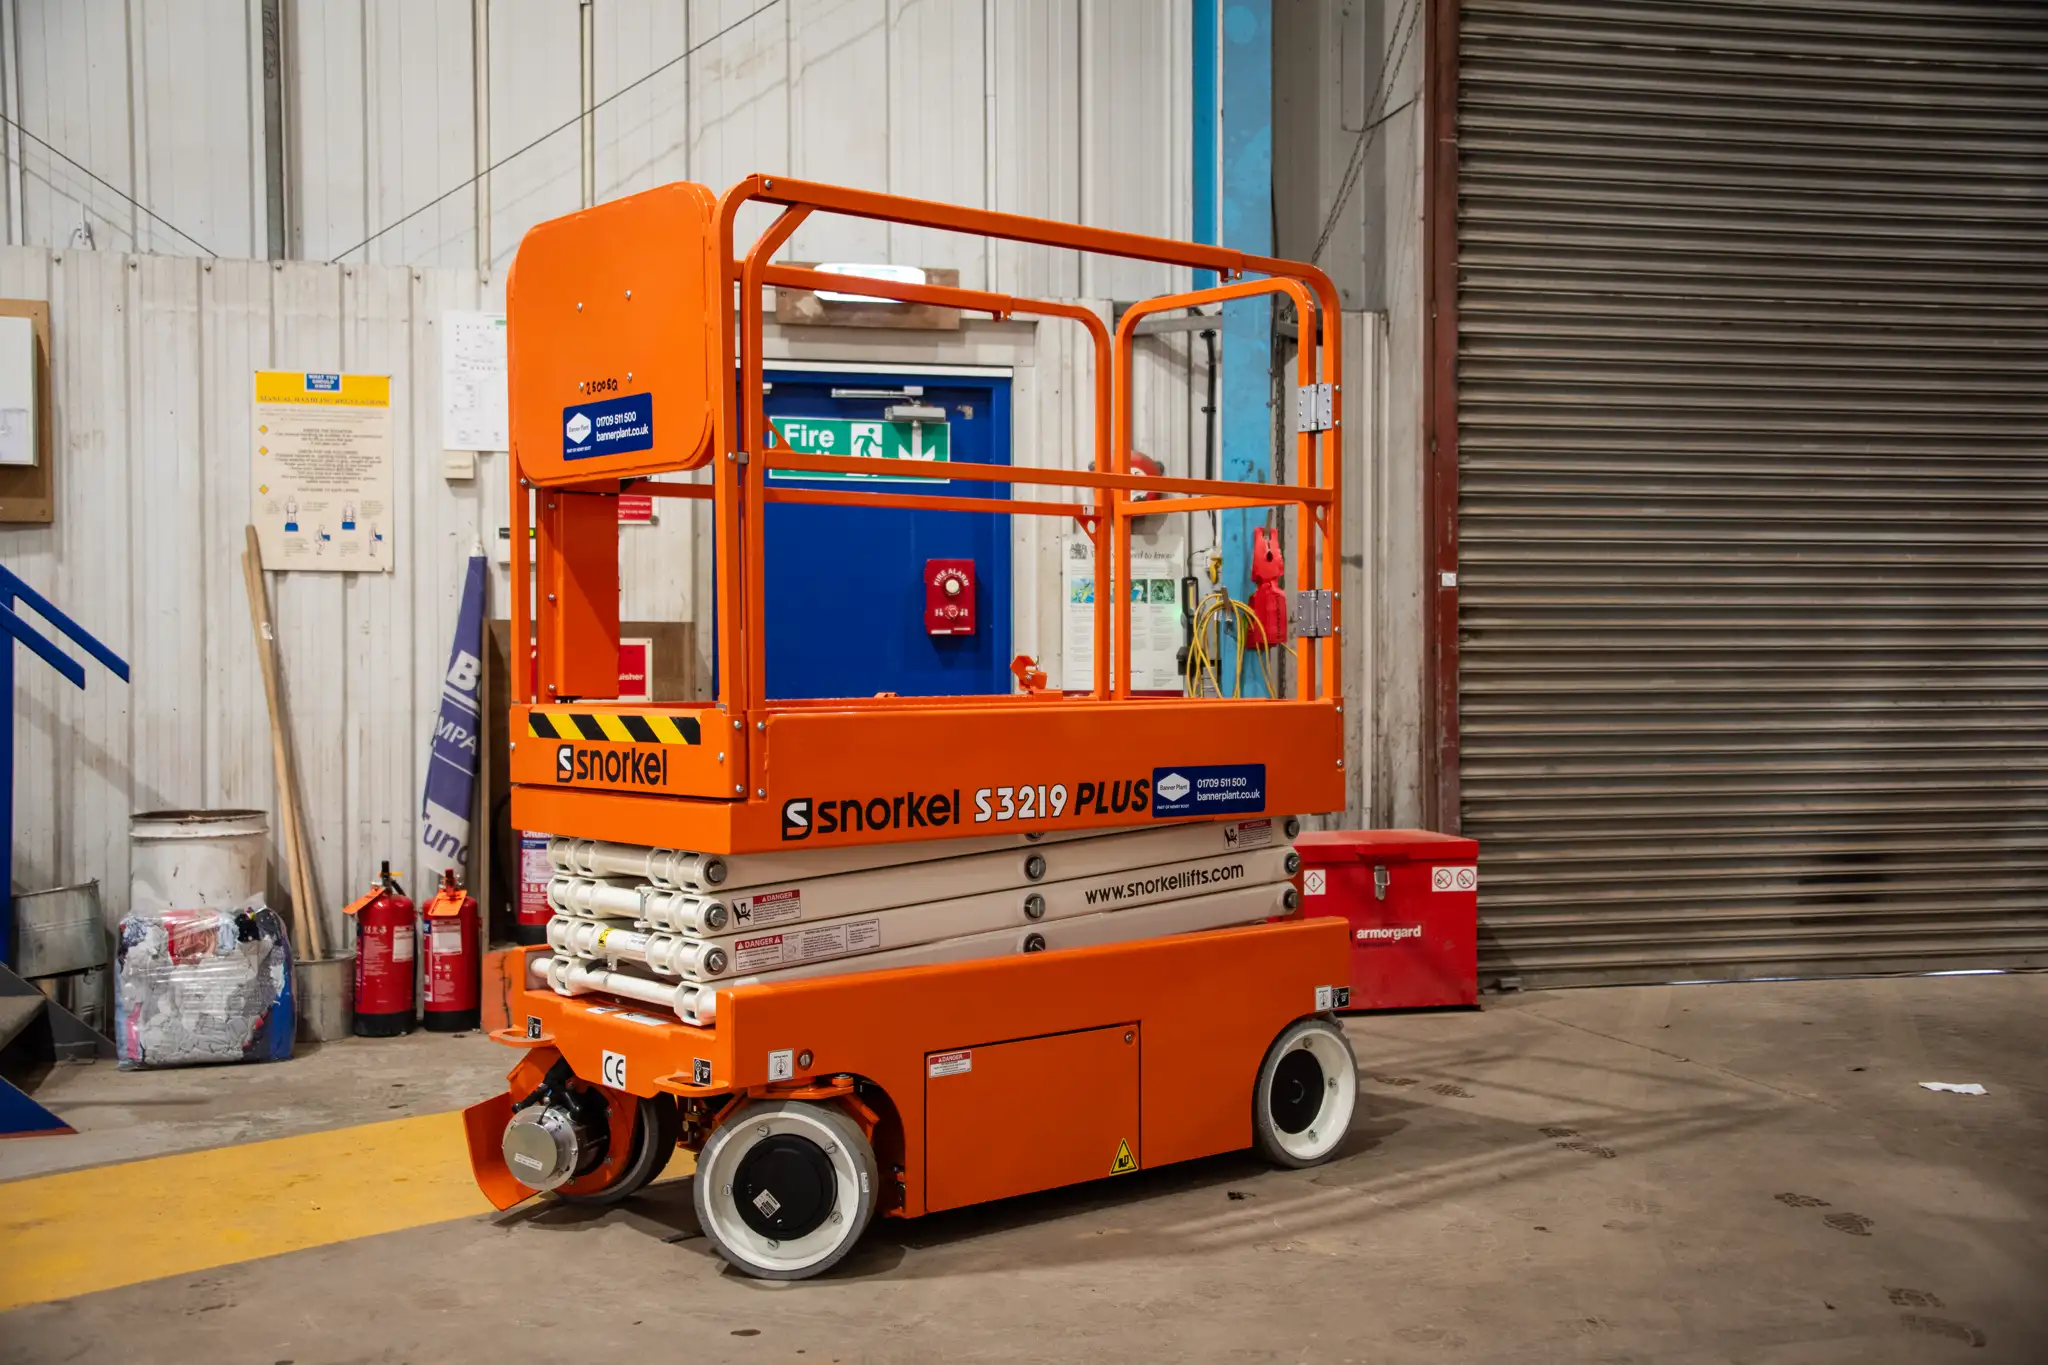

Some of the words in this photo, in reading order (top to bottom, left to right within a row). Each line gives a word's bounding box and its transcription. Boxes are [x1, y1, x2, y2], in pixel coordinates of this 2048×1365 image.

[596, 415, 613, 427] 01709
[614, 413, 623, 425] 511
[624, 411, 636, 423] 500
[596, 423, 649, 441] bannerplant.co.uk
[783, 424, 835, 447] Fire
[934, 569, 948, 586] FIRE
[948, 568, 970, 586] ALARM
[576, 747, 667, 786] snorkel
[1197, 778, 1219, 788] 01709
[1220, 777, 1231, 787] 511
[1232, 777, 1247, 787] 500
[1197, 789, 1260, 802] bannerplant.co.uk
[817, 789, 960, 834] snorkel
[974, 784, 1068, 823] S3219
[1074, 778, 1150, 816] PLUS
[1085, 864, 1244, 904] www.snorkellifts.com
[766, 892, 793, 902] DANGER
[1356, 925, 1422, 940] armorgard
[744, 938, 774, 949] DANGER
[942, 1054, 963, 1063] DANGER
